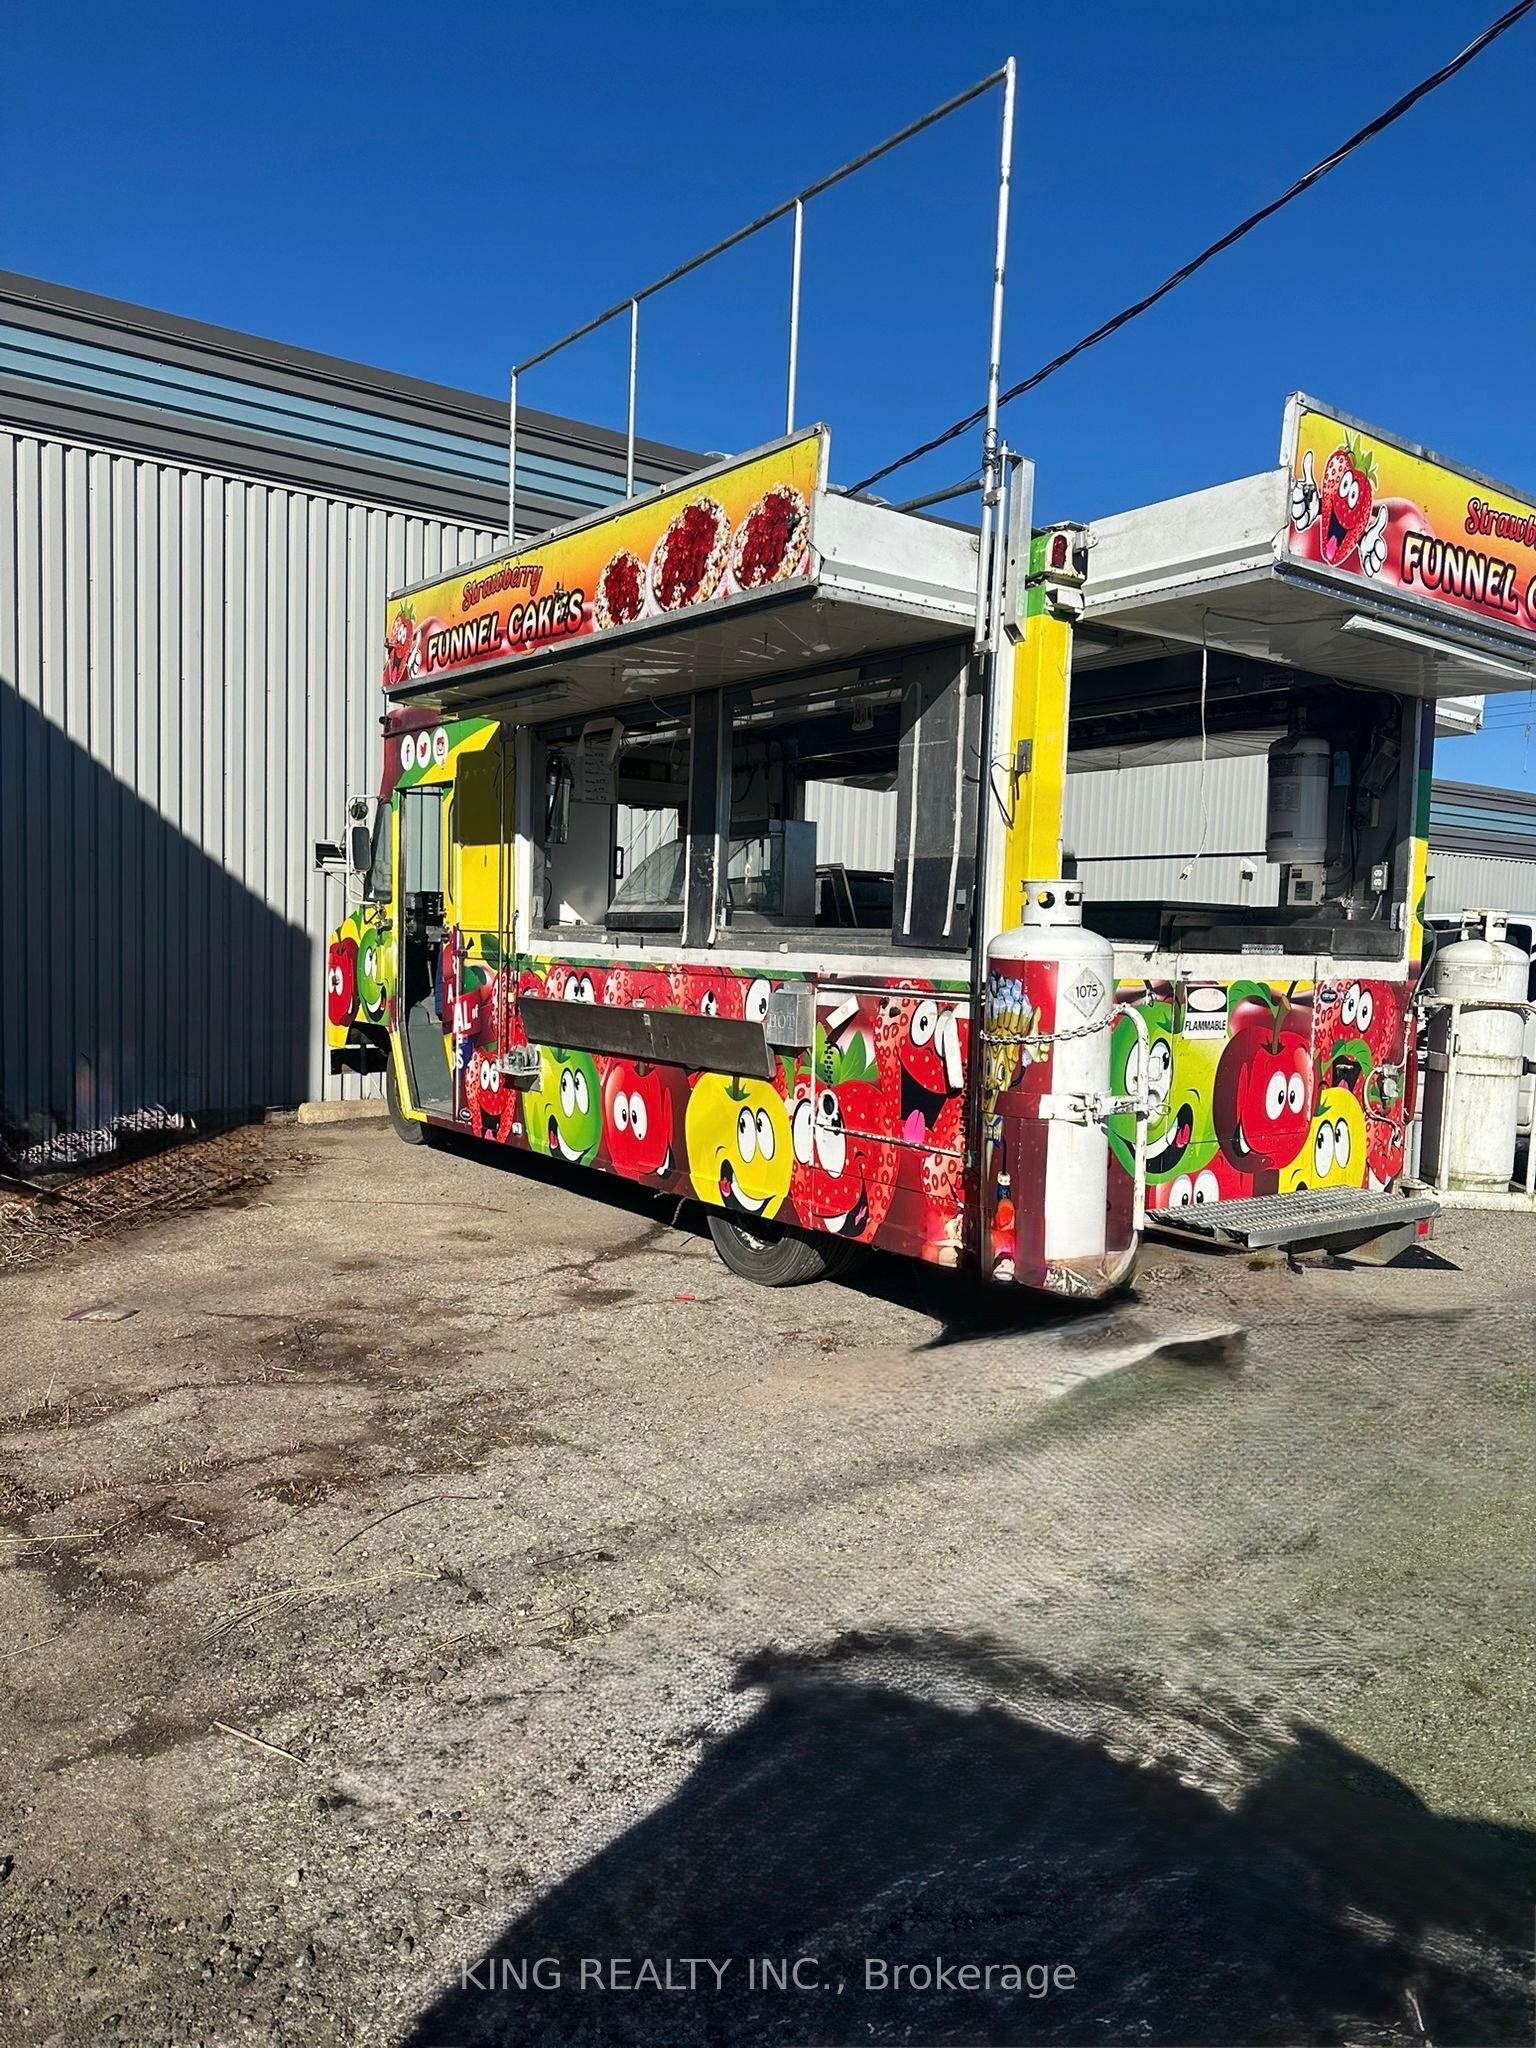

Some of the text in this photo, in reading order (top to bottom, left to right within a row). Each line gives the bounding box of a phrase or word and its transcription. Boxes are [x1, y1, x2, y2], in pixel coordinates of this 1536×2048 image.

[1465, 497, 1536, 550] Strawb
[462, 564, 543, 612] Strawberry
[1402, 531, 1518, 615] FUNNEL
[427, 588, 584, 671] FUNNEL CAKES
[1075, 984, 1099, 999] 1075
[769, 1013, 796, 1029] HOT
[1184, 1020, 1226, 1031] FLAMMABLE
